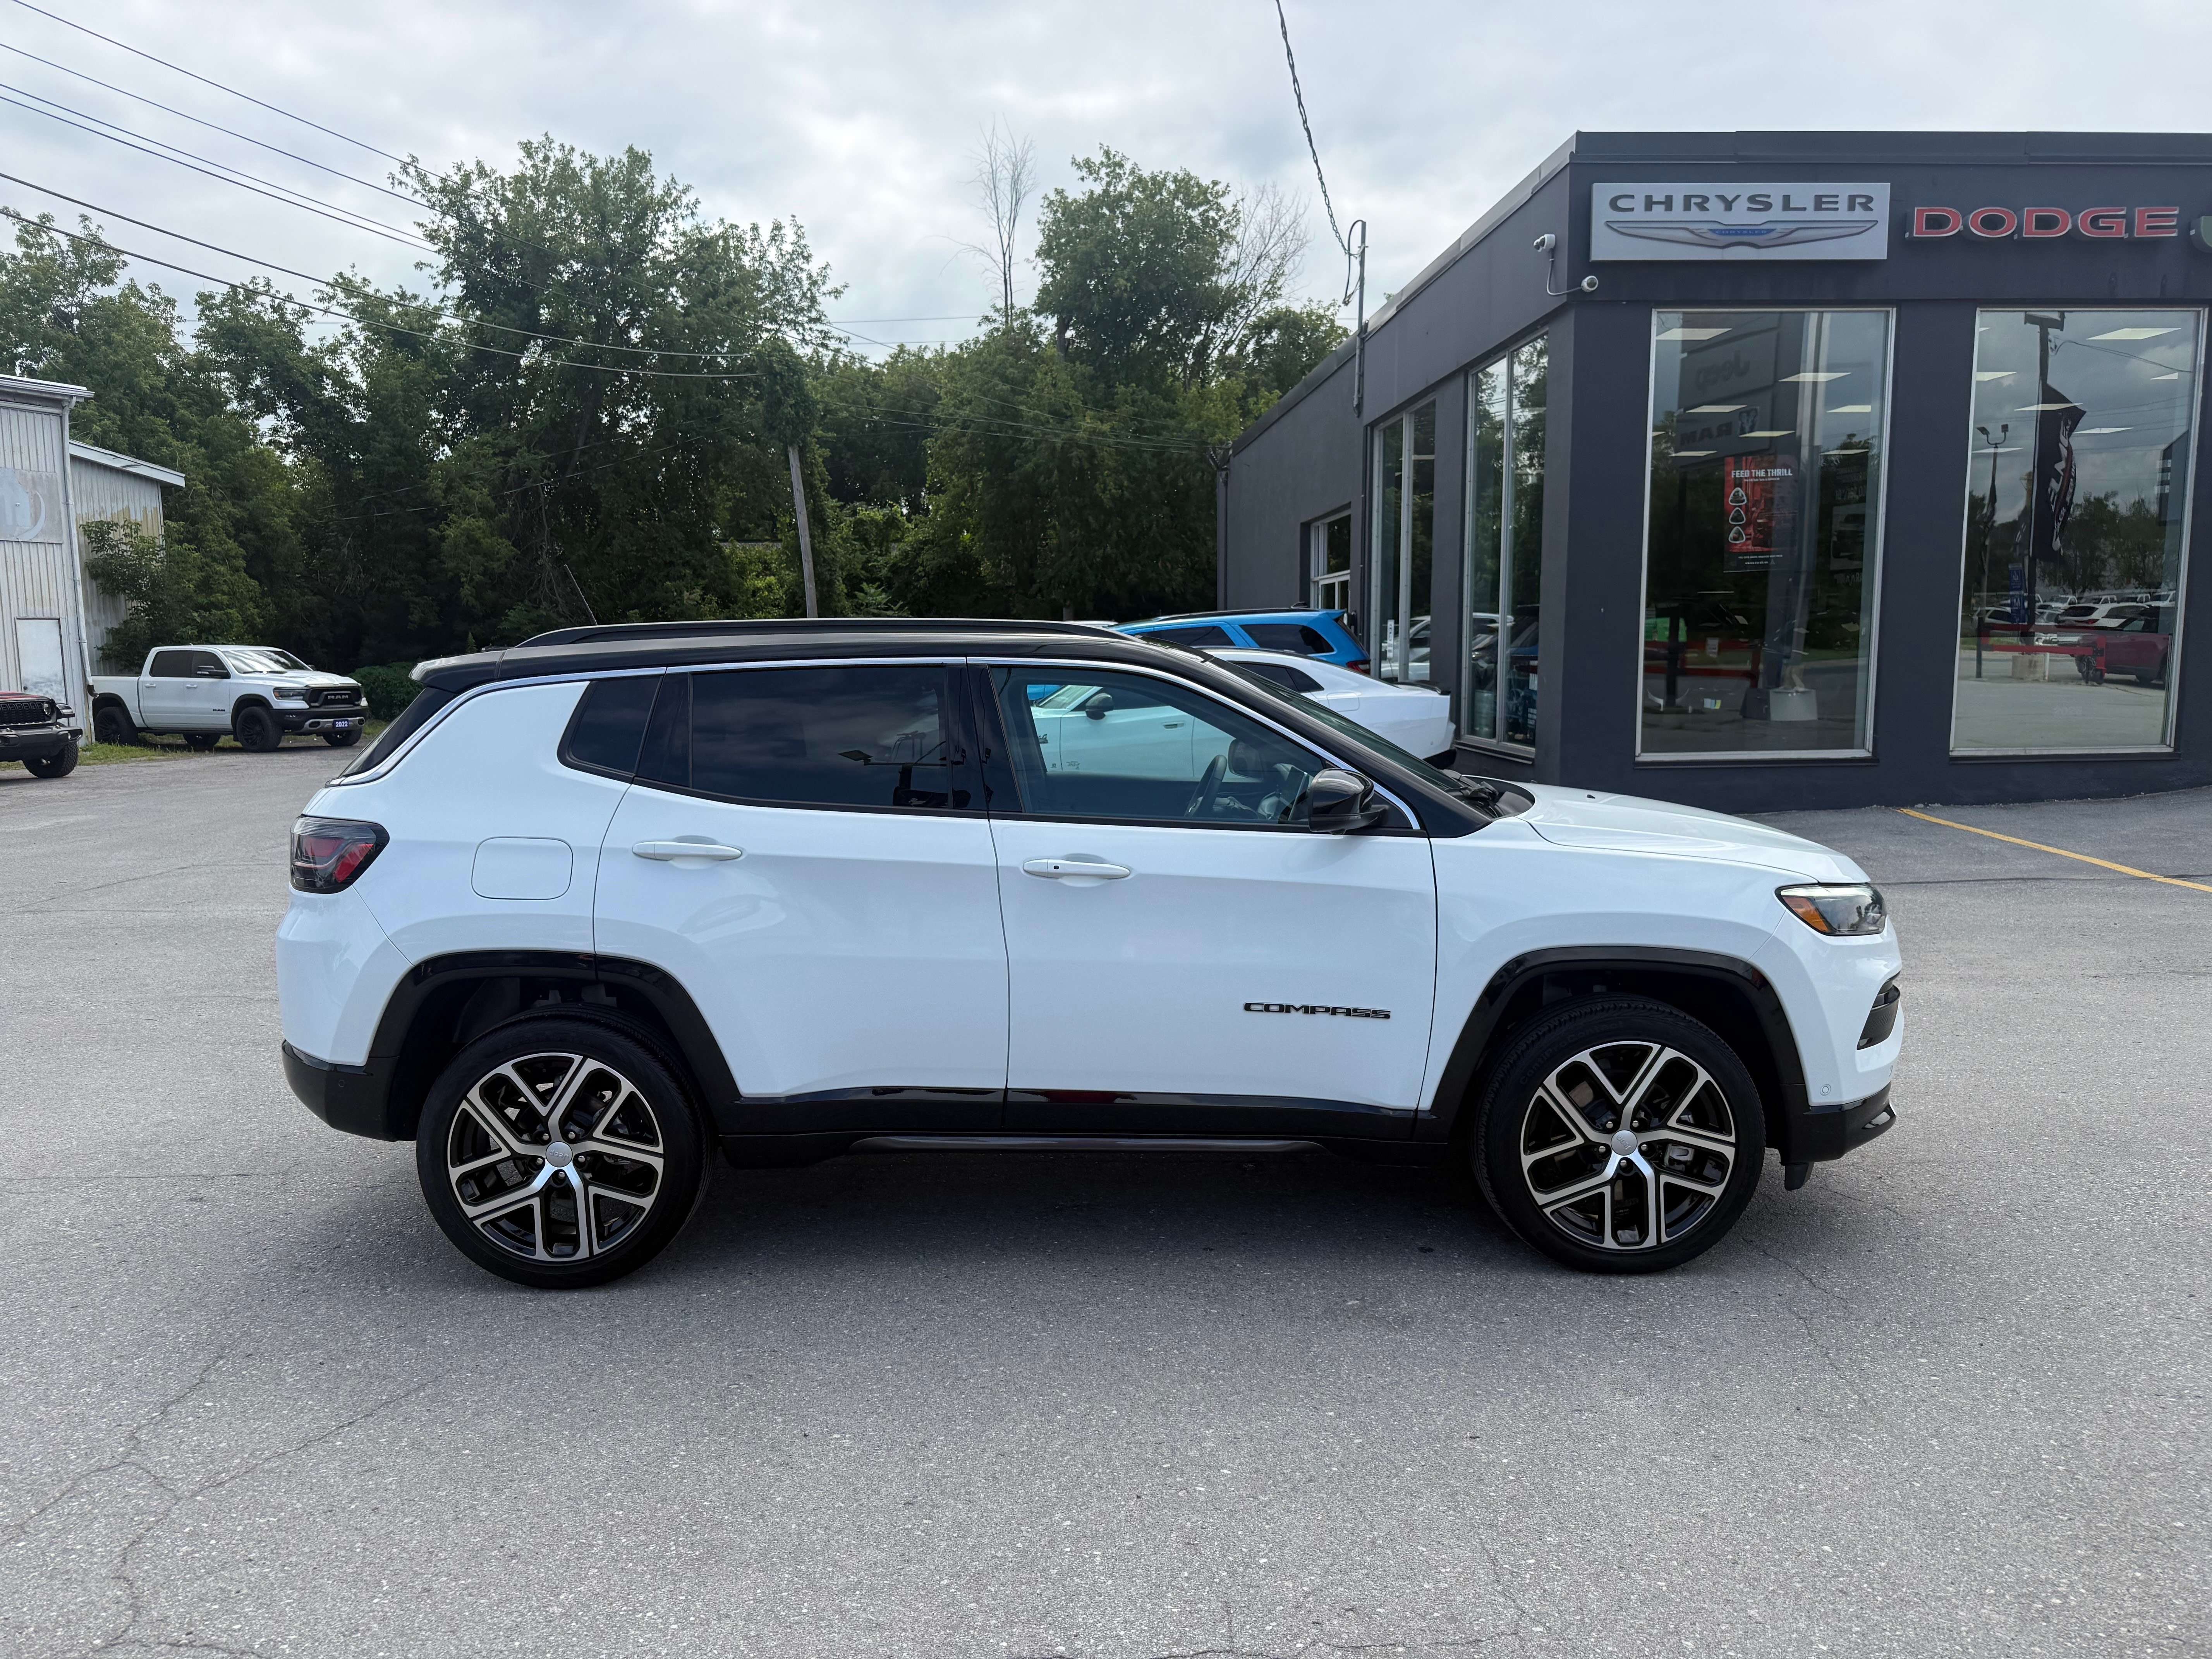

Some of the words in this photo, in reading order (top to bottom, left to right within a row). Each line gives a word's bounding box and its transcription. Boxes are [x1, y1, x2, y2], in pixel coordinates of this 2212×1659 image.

[1609, 194, 1874, 212] CHRYSLER
[1913, 206, 2179, 237] DODGE
[1731, 470, 1750, 478] FEED
[1751, 469, 1765, 477] THE
[1767, 468, 1793, 477] THRILL
[1243, 1001, 1391, 1019] COMPASS
[1617, 1134, 1632, 1151] Jeep
[550, 1149, 569, 1161] Jeep
